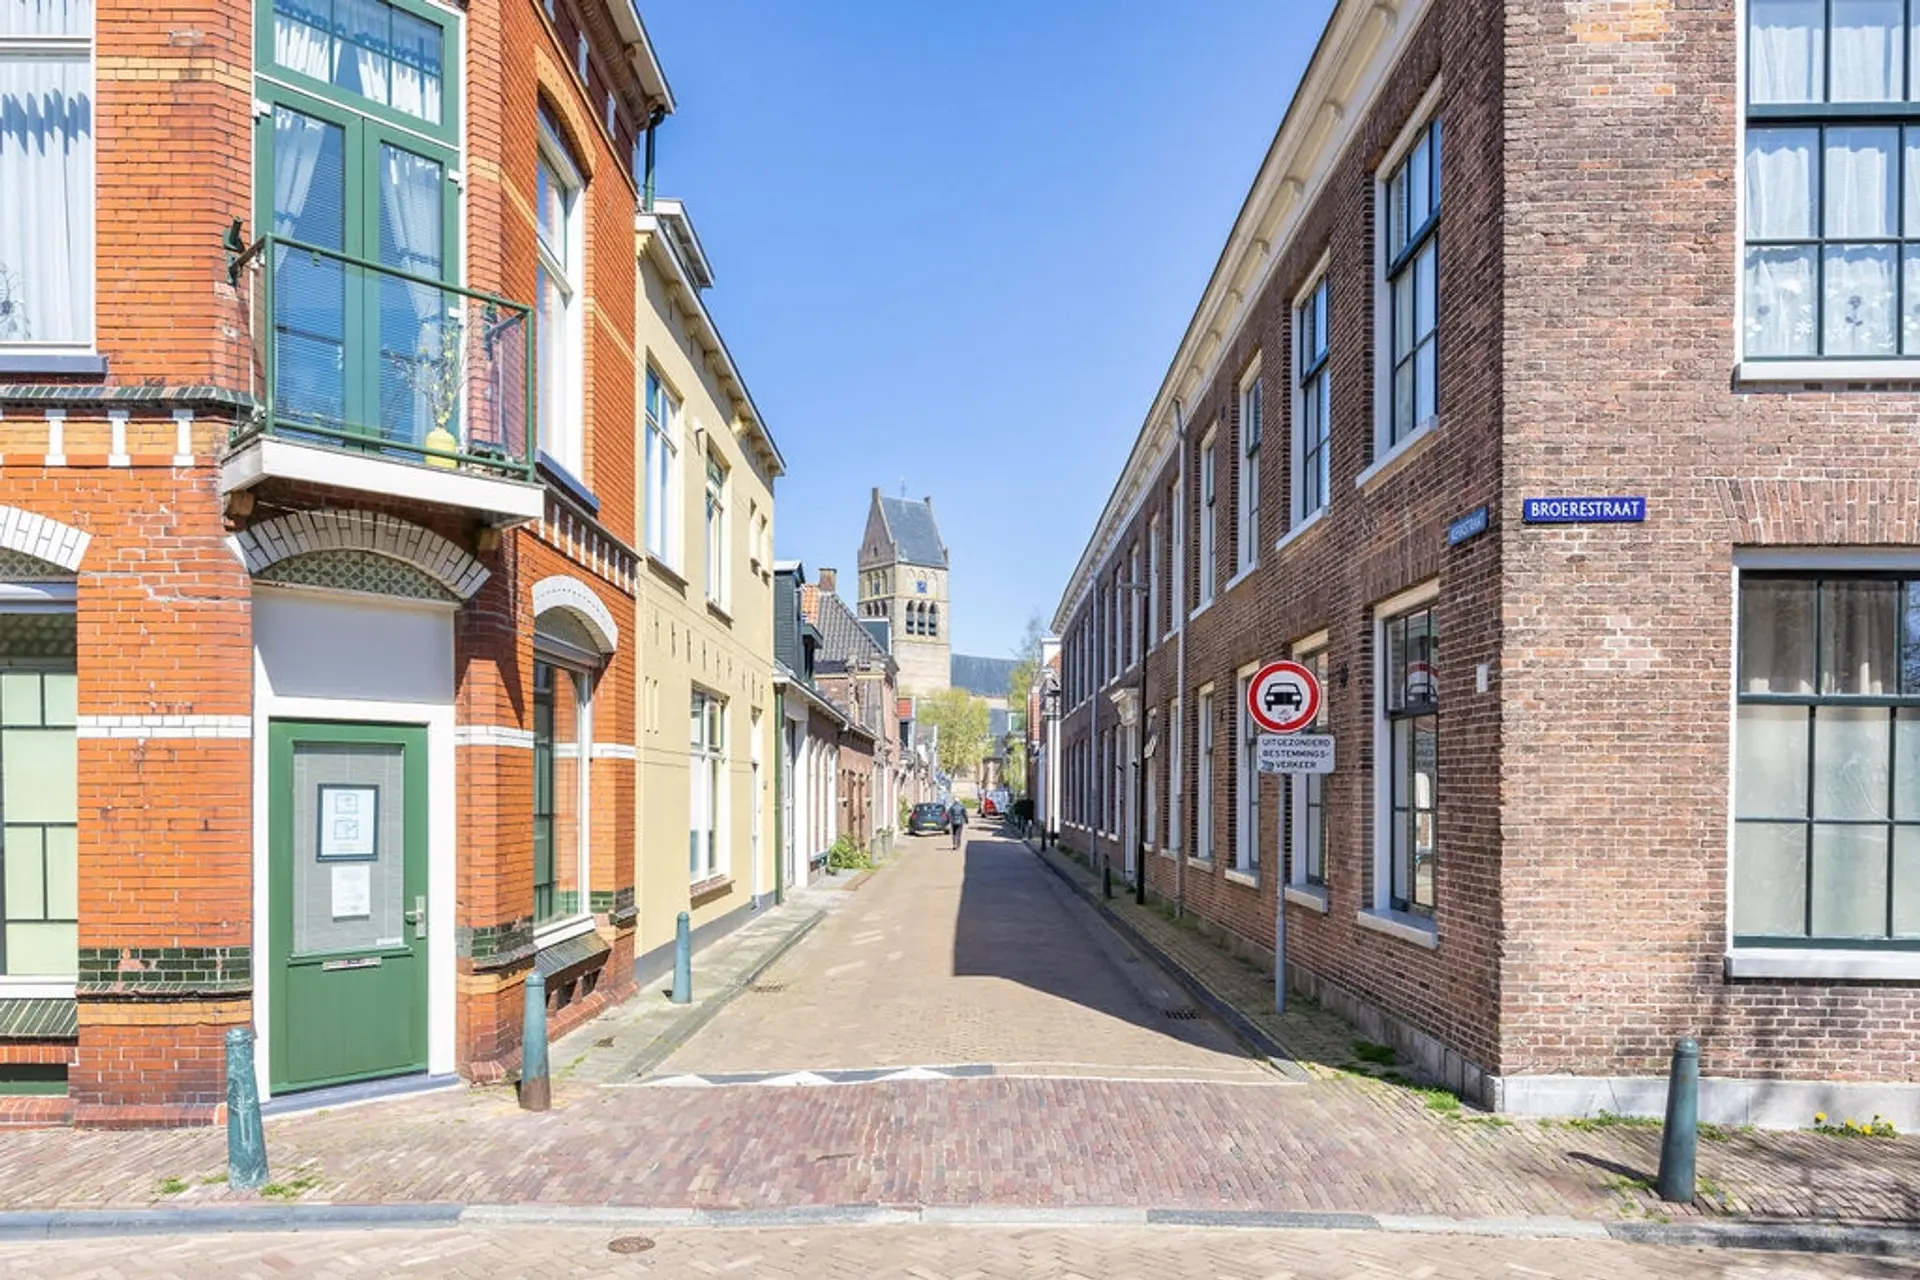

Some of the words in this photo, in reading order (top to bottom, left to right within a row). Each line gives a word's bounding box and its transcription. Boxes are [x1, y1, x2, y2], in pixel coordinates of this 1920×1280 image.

[1531, 501, 1640, 517] BROERESTRAAT
[1262, 738, 1331, 746] UITGEZONDERD
[1275, 761, 1317, 769] VERKEER
